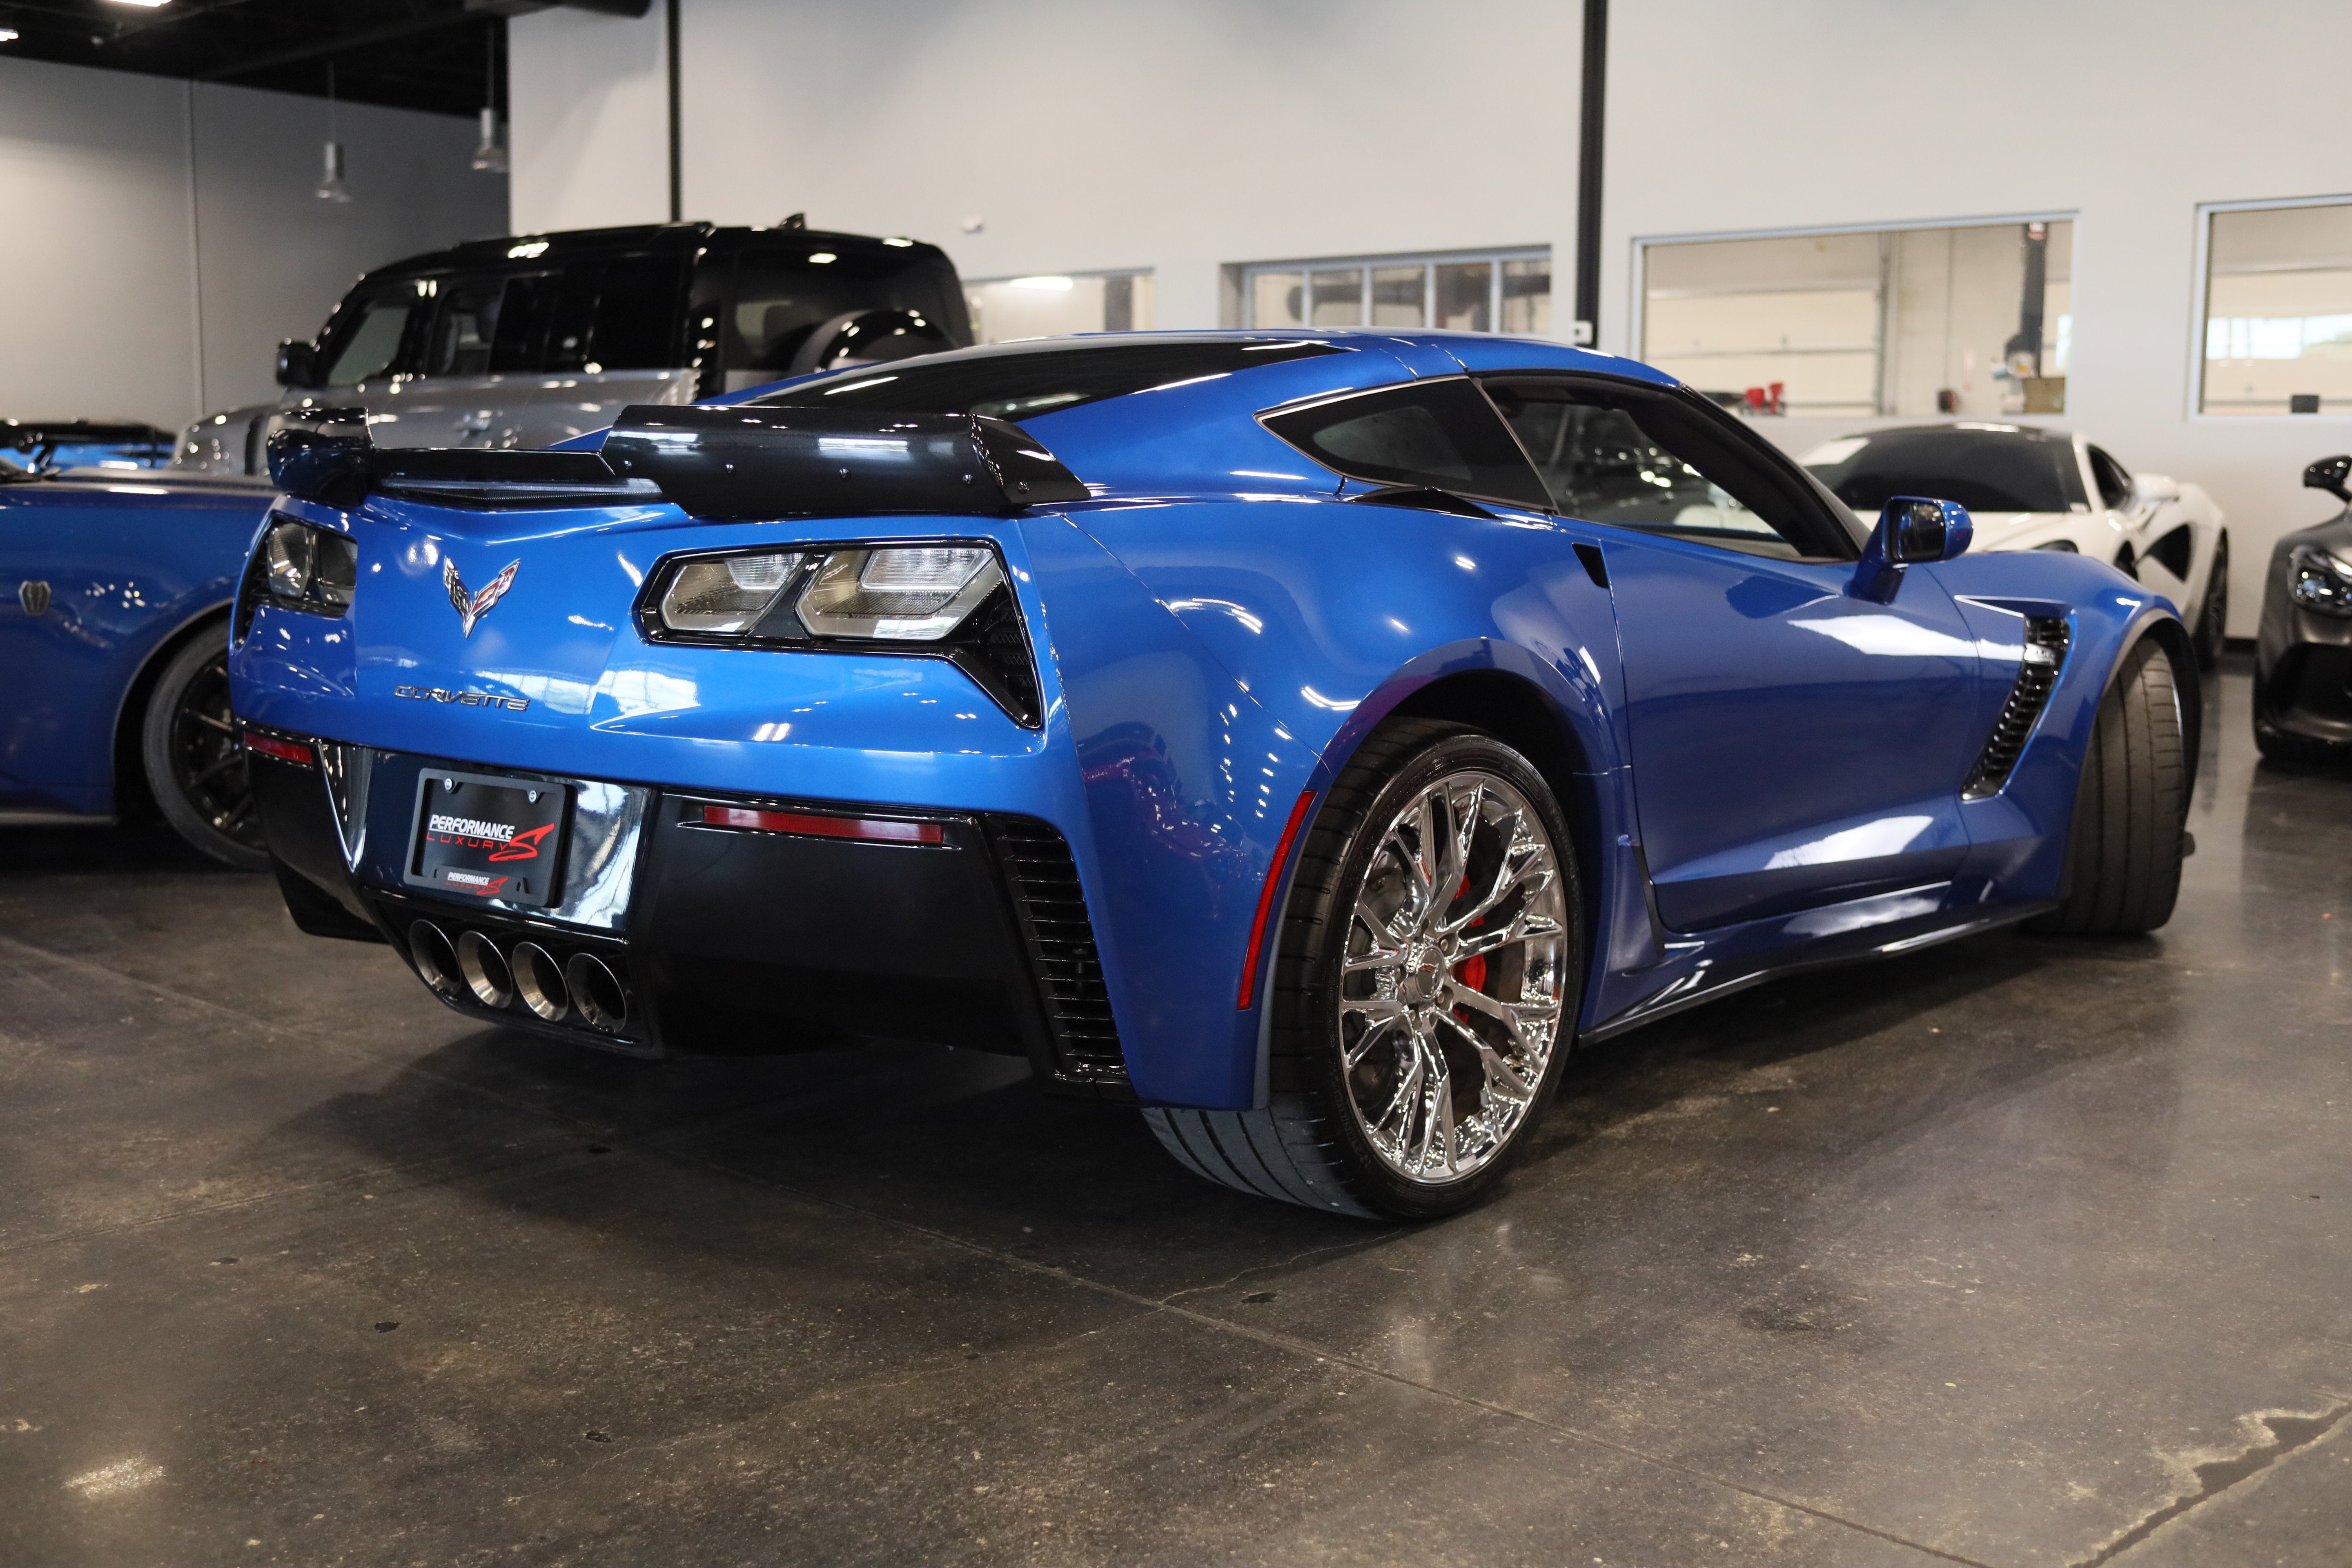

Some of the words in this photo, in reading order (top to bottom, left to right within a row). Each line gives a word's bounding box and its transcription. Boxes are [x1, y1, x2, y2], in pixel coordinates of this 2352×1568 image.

[395, 686, 530, 711] CORVETTE
[429, 814, 515, 840] PERFORMANCE
[426, 832, 508, 851] LUXURY
[448, 871, 490, 885] PERFORMANCE
